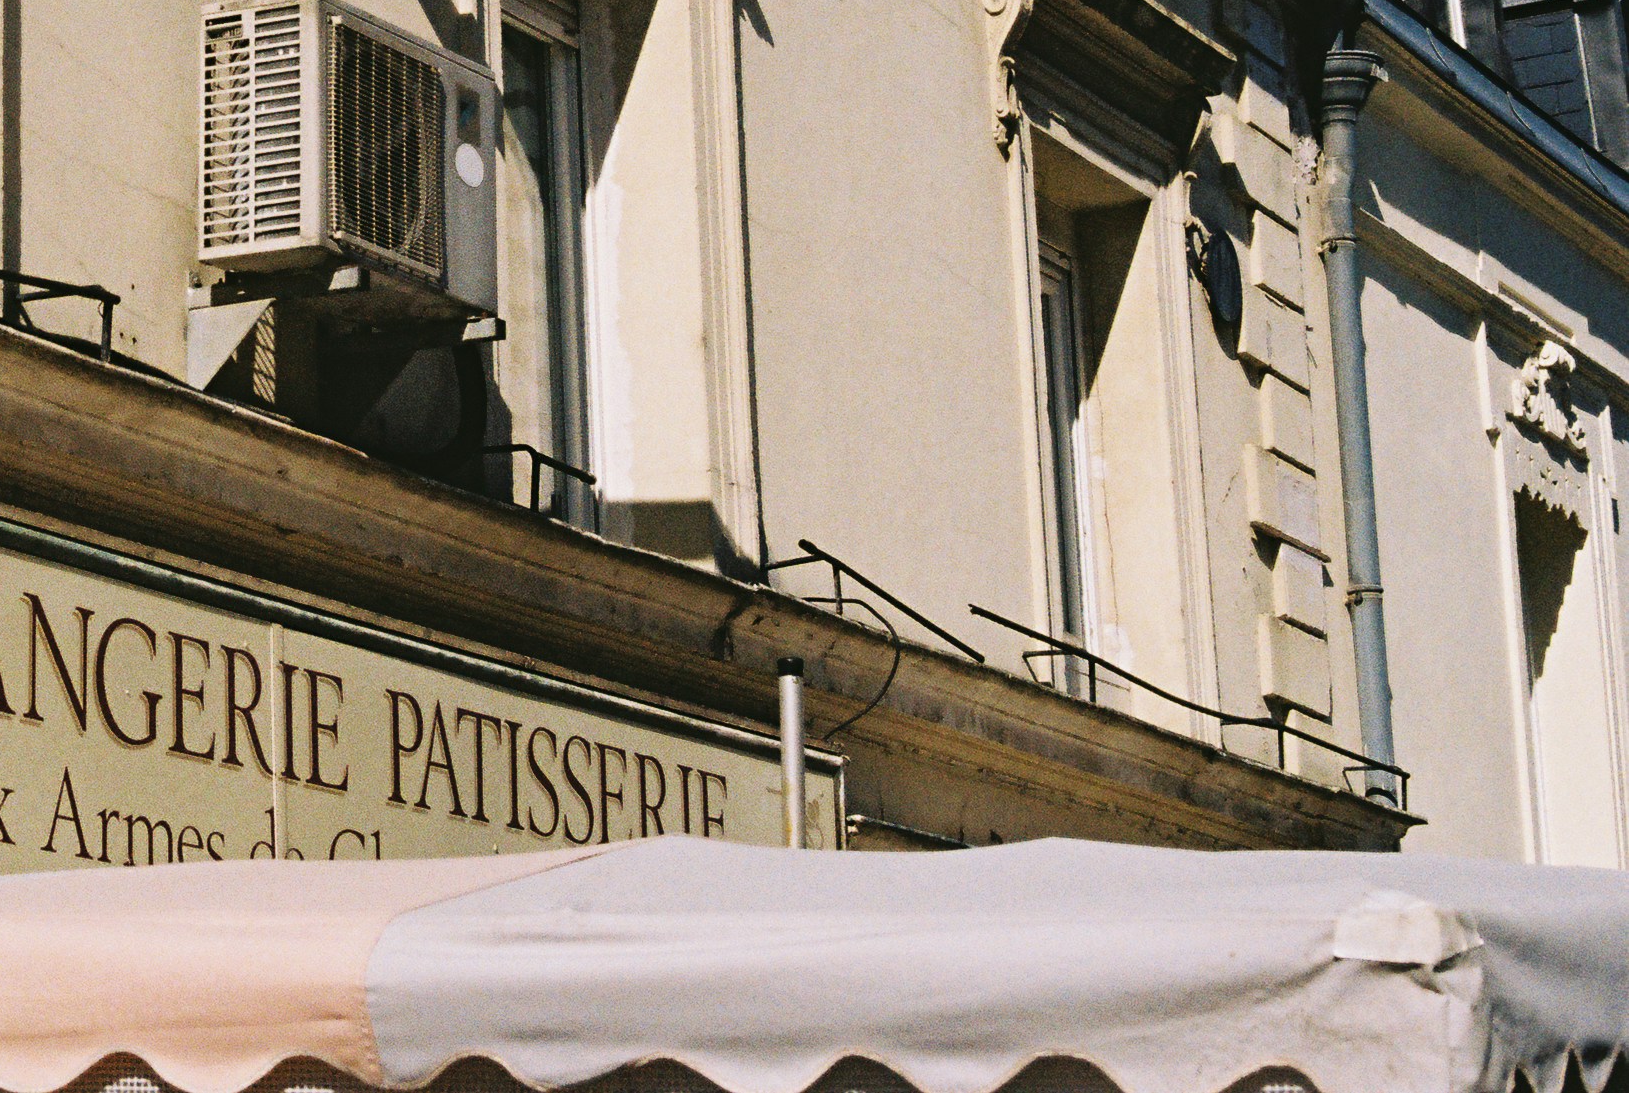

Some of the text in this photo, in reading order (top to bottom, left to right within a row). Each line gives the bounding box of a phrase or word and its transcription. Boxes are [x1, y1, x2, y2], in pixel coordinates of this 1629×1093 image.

[40, 766, 226, 866] Armes
[250, 806, 305, 860] d
[385, 688, 727, 845] PATISSERIE
